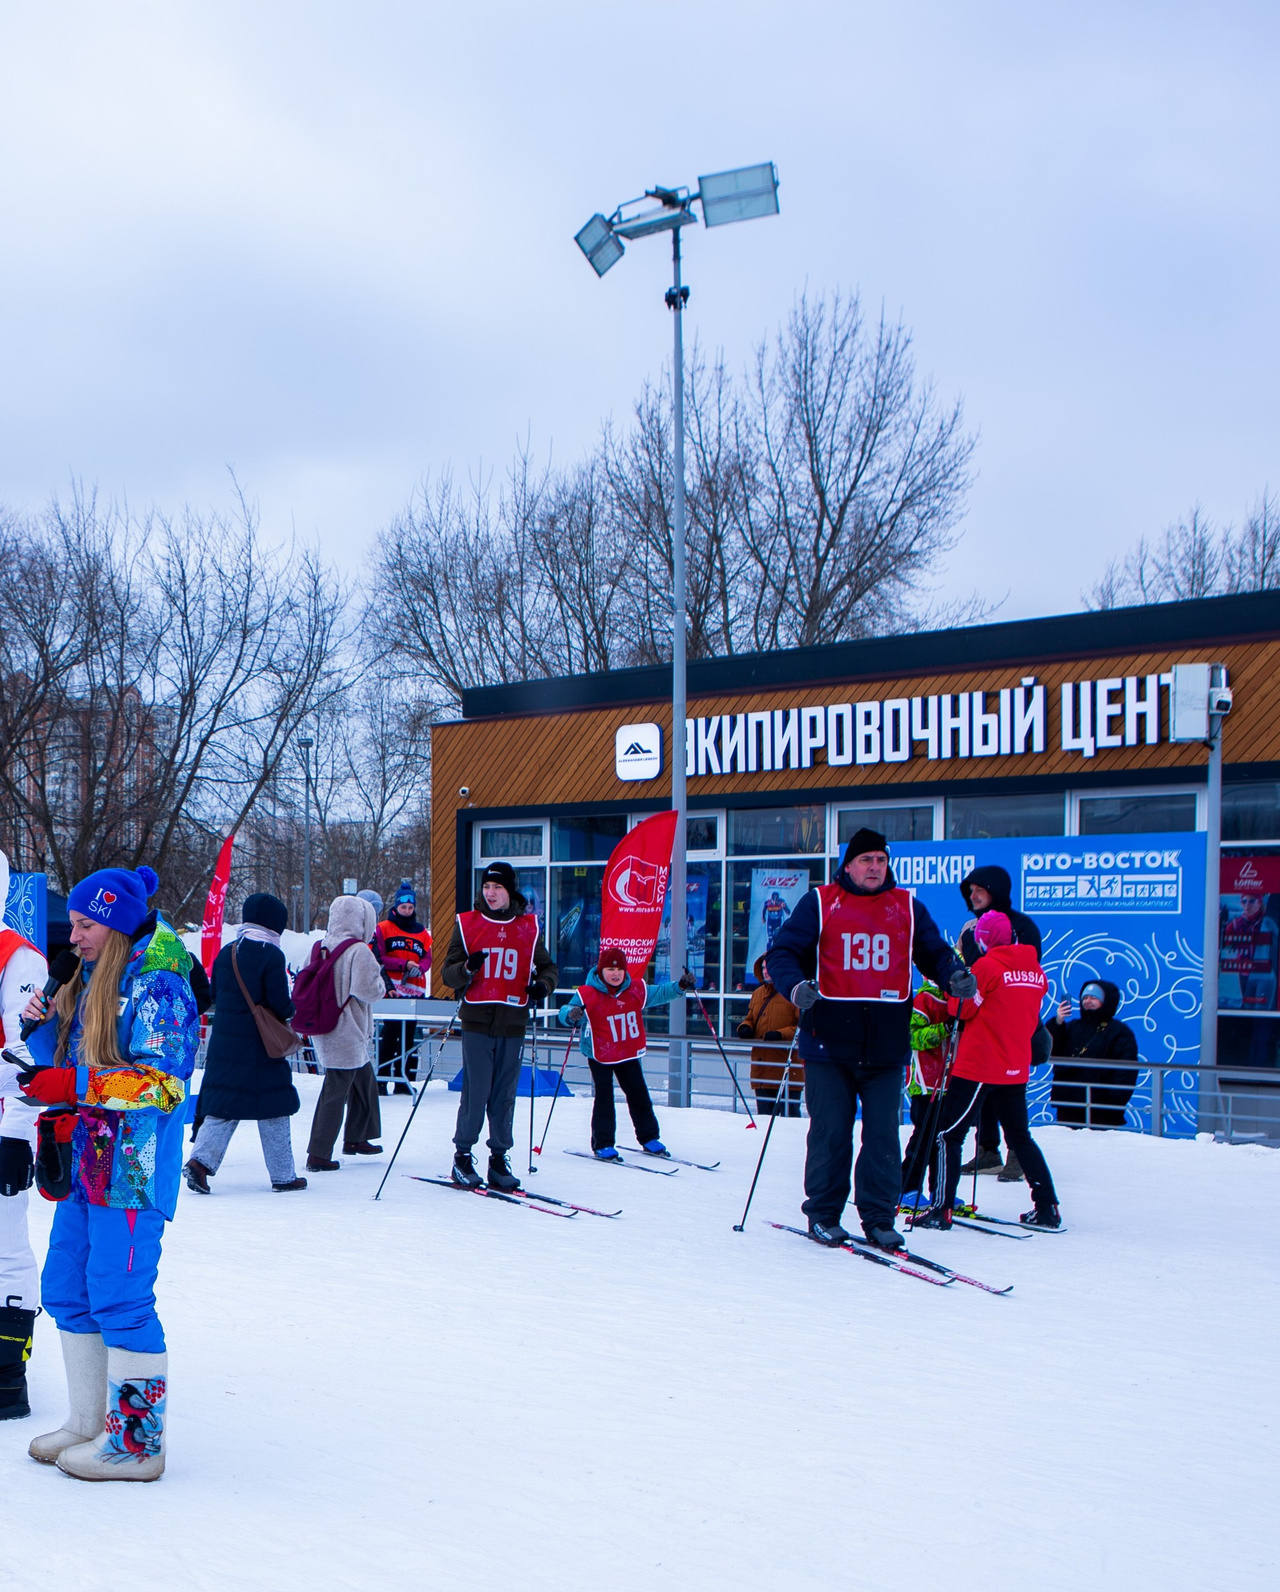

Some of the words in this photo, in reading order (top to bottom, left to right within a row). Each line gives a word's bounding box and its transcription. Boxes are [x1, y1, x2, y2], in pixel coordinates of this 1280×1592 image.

[1061, 673, 1173, 757] ЦЕН
[889, 855, 975, 884] КОВСКАЯ
[1021, 850, 1182, 870] ЮГО-ВОСТОК
[95, 888, 104, 900] I
[88, 901, 111, 918] SKI
[599, 937, 656, 947] МОСКОВСКИ
[841, 932, 890, 971] 138
[482, 947, 518, 980] 179
[1003, 970, 1045, 986] RUSSIA
[606, 1011, 640, 1043] 178
